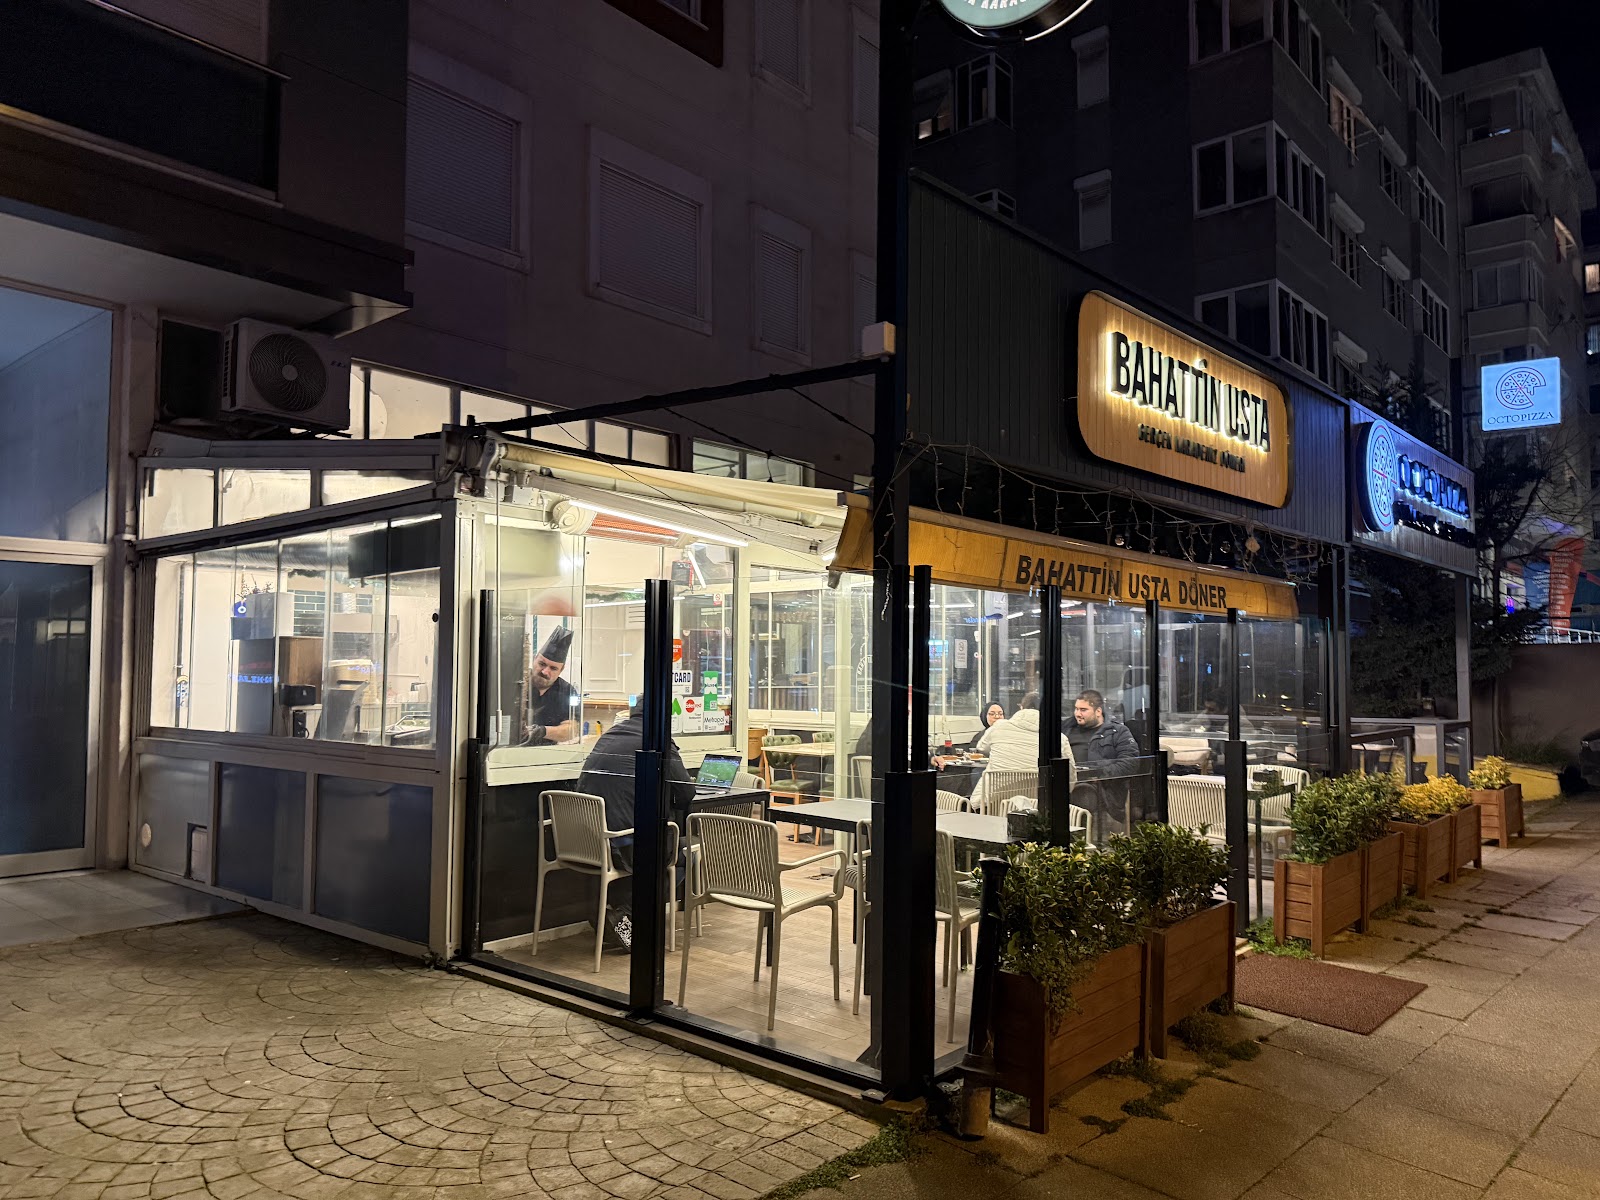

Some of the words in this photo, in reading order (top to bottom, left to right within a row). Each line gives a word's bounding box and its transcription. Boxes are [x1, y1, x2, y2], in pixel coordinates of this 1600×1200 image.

[1110, 331, 1222, 433] BAHATTİN
[1223, 383, 1271, 453] USTA
[1487, 411, 1555, 425] OCTOPIZZA
[1015, 554, 1121, 597] BAHATTİN
[1128, 572, 1171, 603] USTA
[1178, 576, 1227, 609] DÖNER
